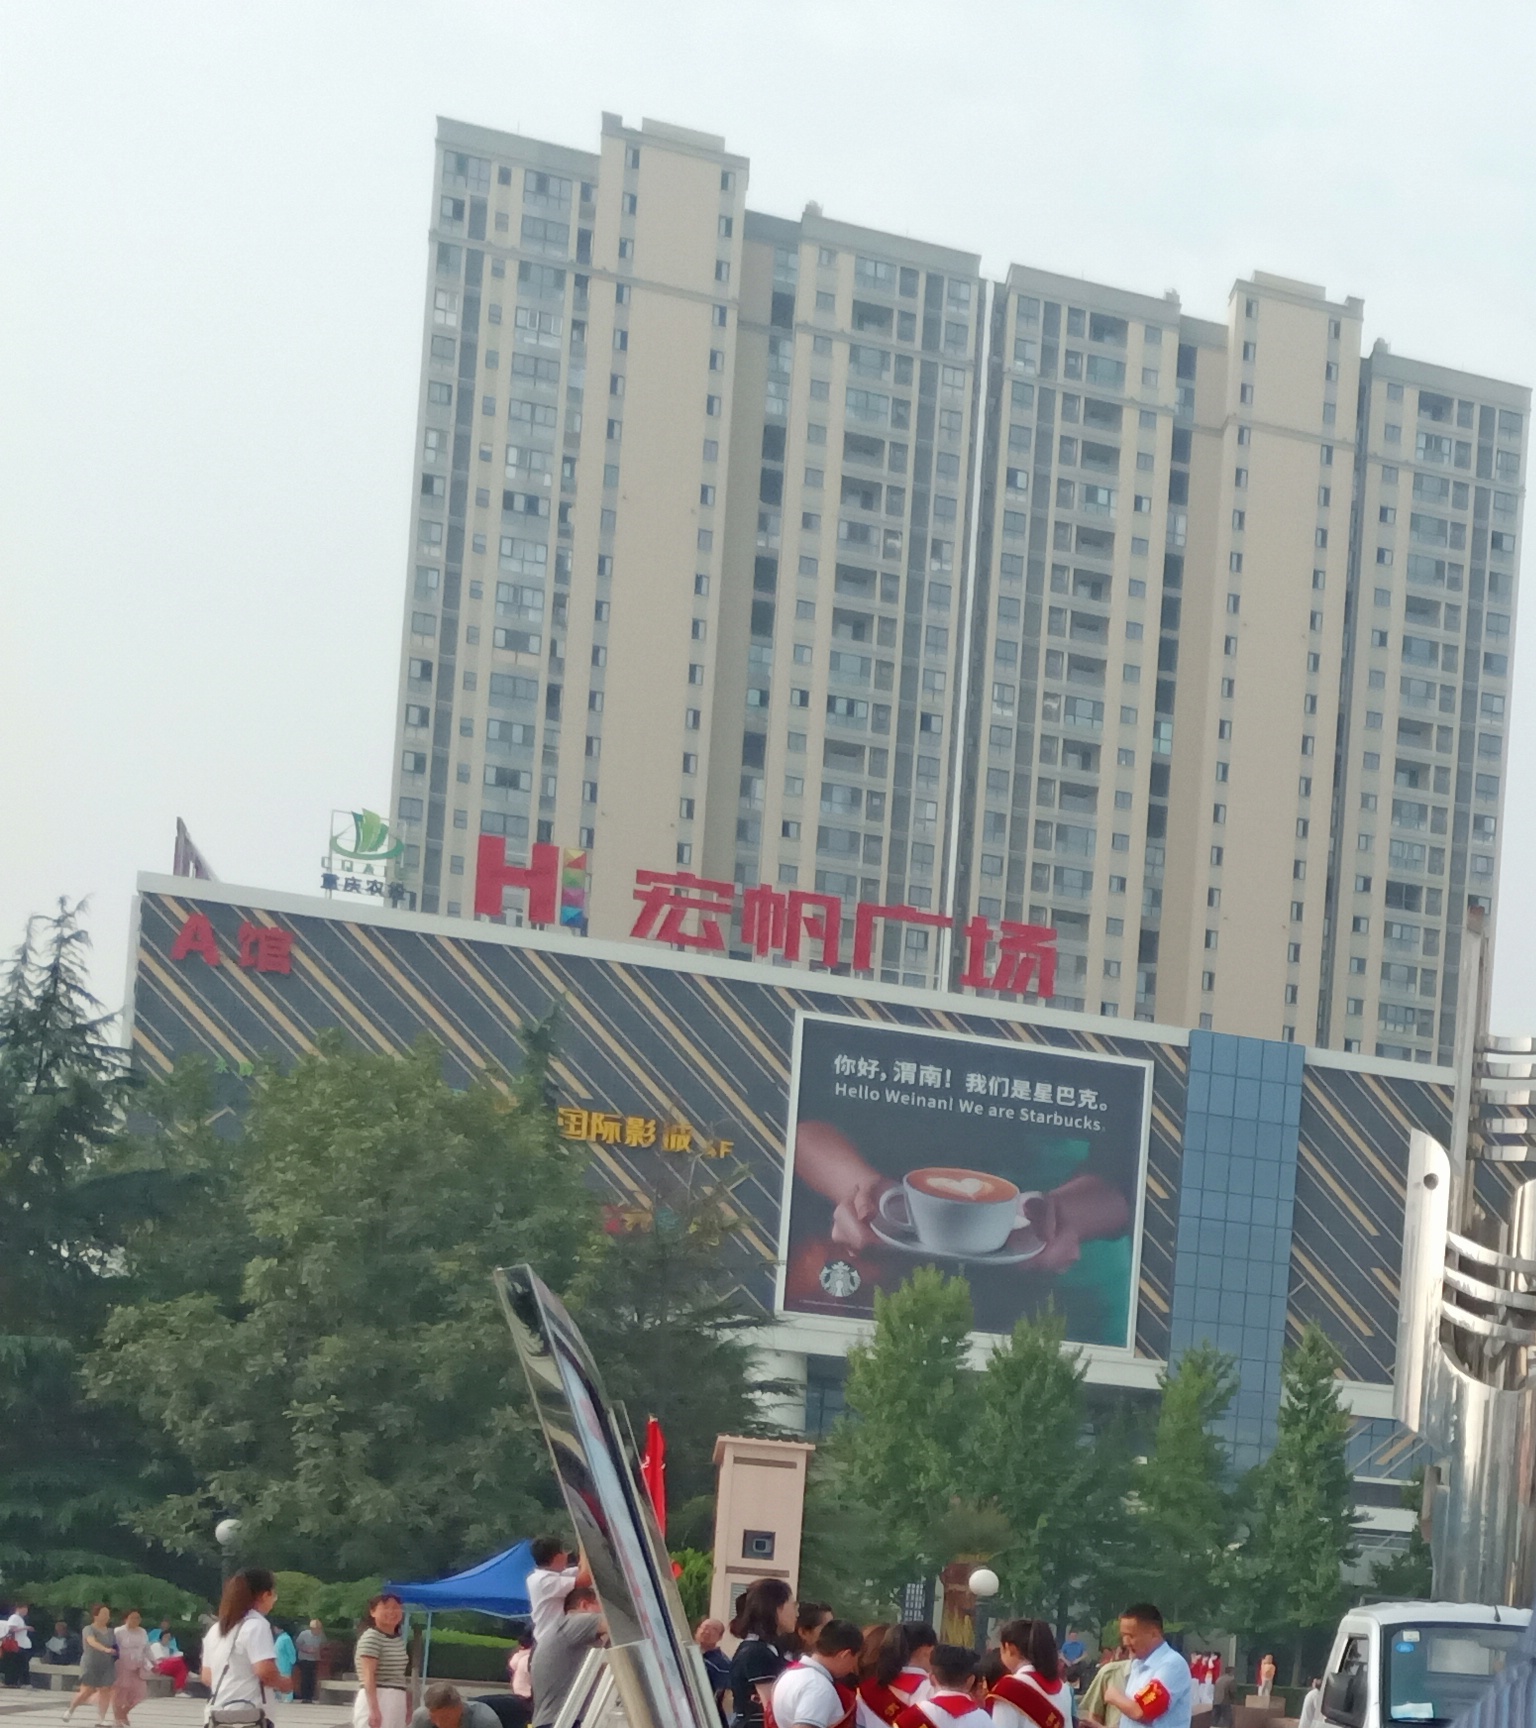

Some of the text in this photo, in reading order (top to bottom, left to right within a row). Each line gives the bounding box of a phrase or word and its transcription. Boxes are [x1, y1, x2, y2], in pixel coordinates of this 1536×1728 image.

[630, 869, 1059, 999] 宏帆广场
[835, 1082, 880, 1102] Hello
[885, 1089, 954, 1112] Weinan!
[959, 1098, 984, 1115] We
[988, 1106, 1015, 1119] are
